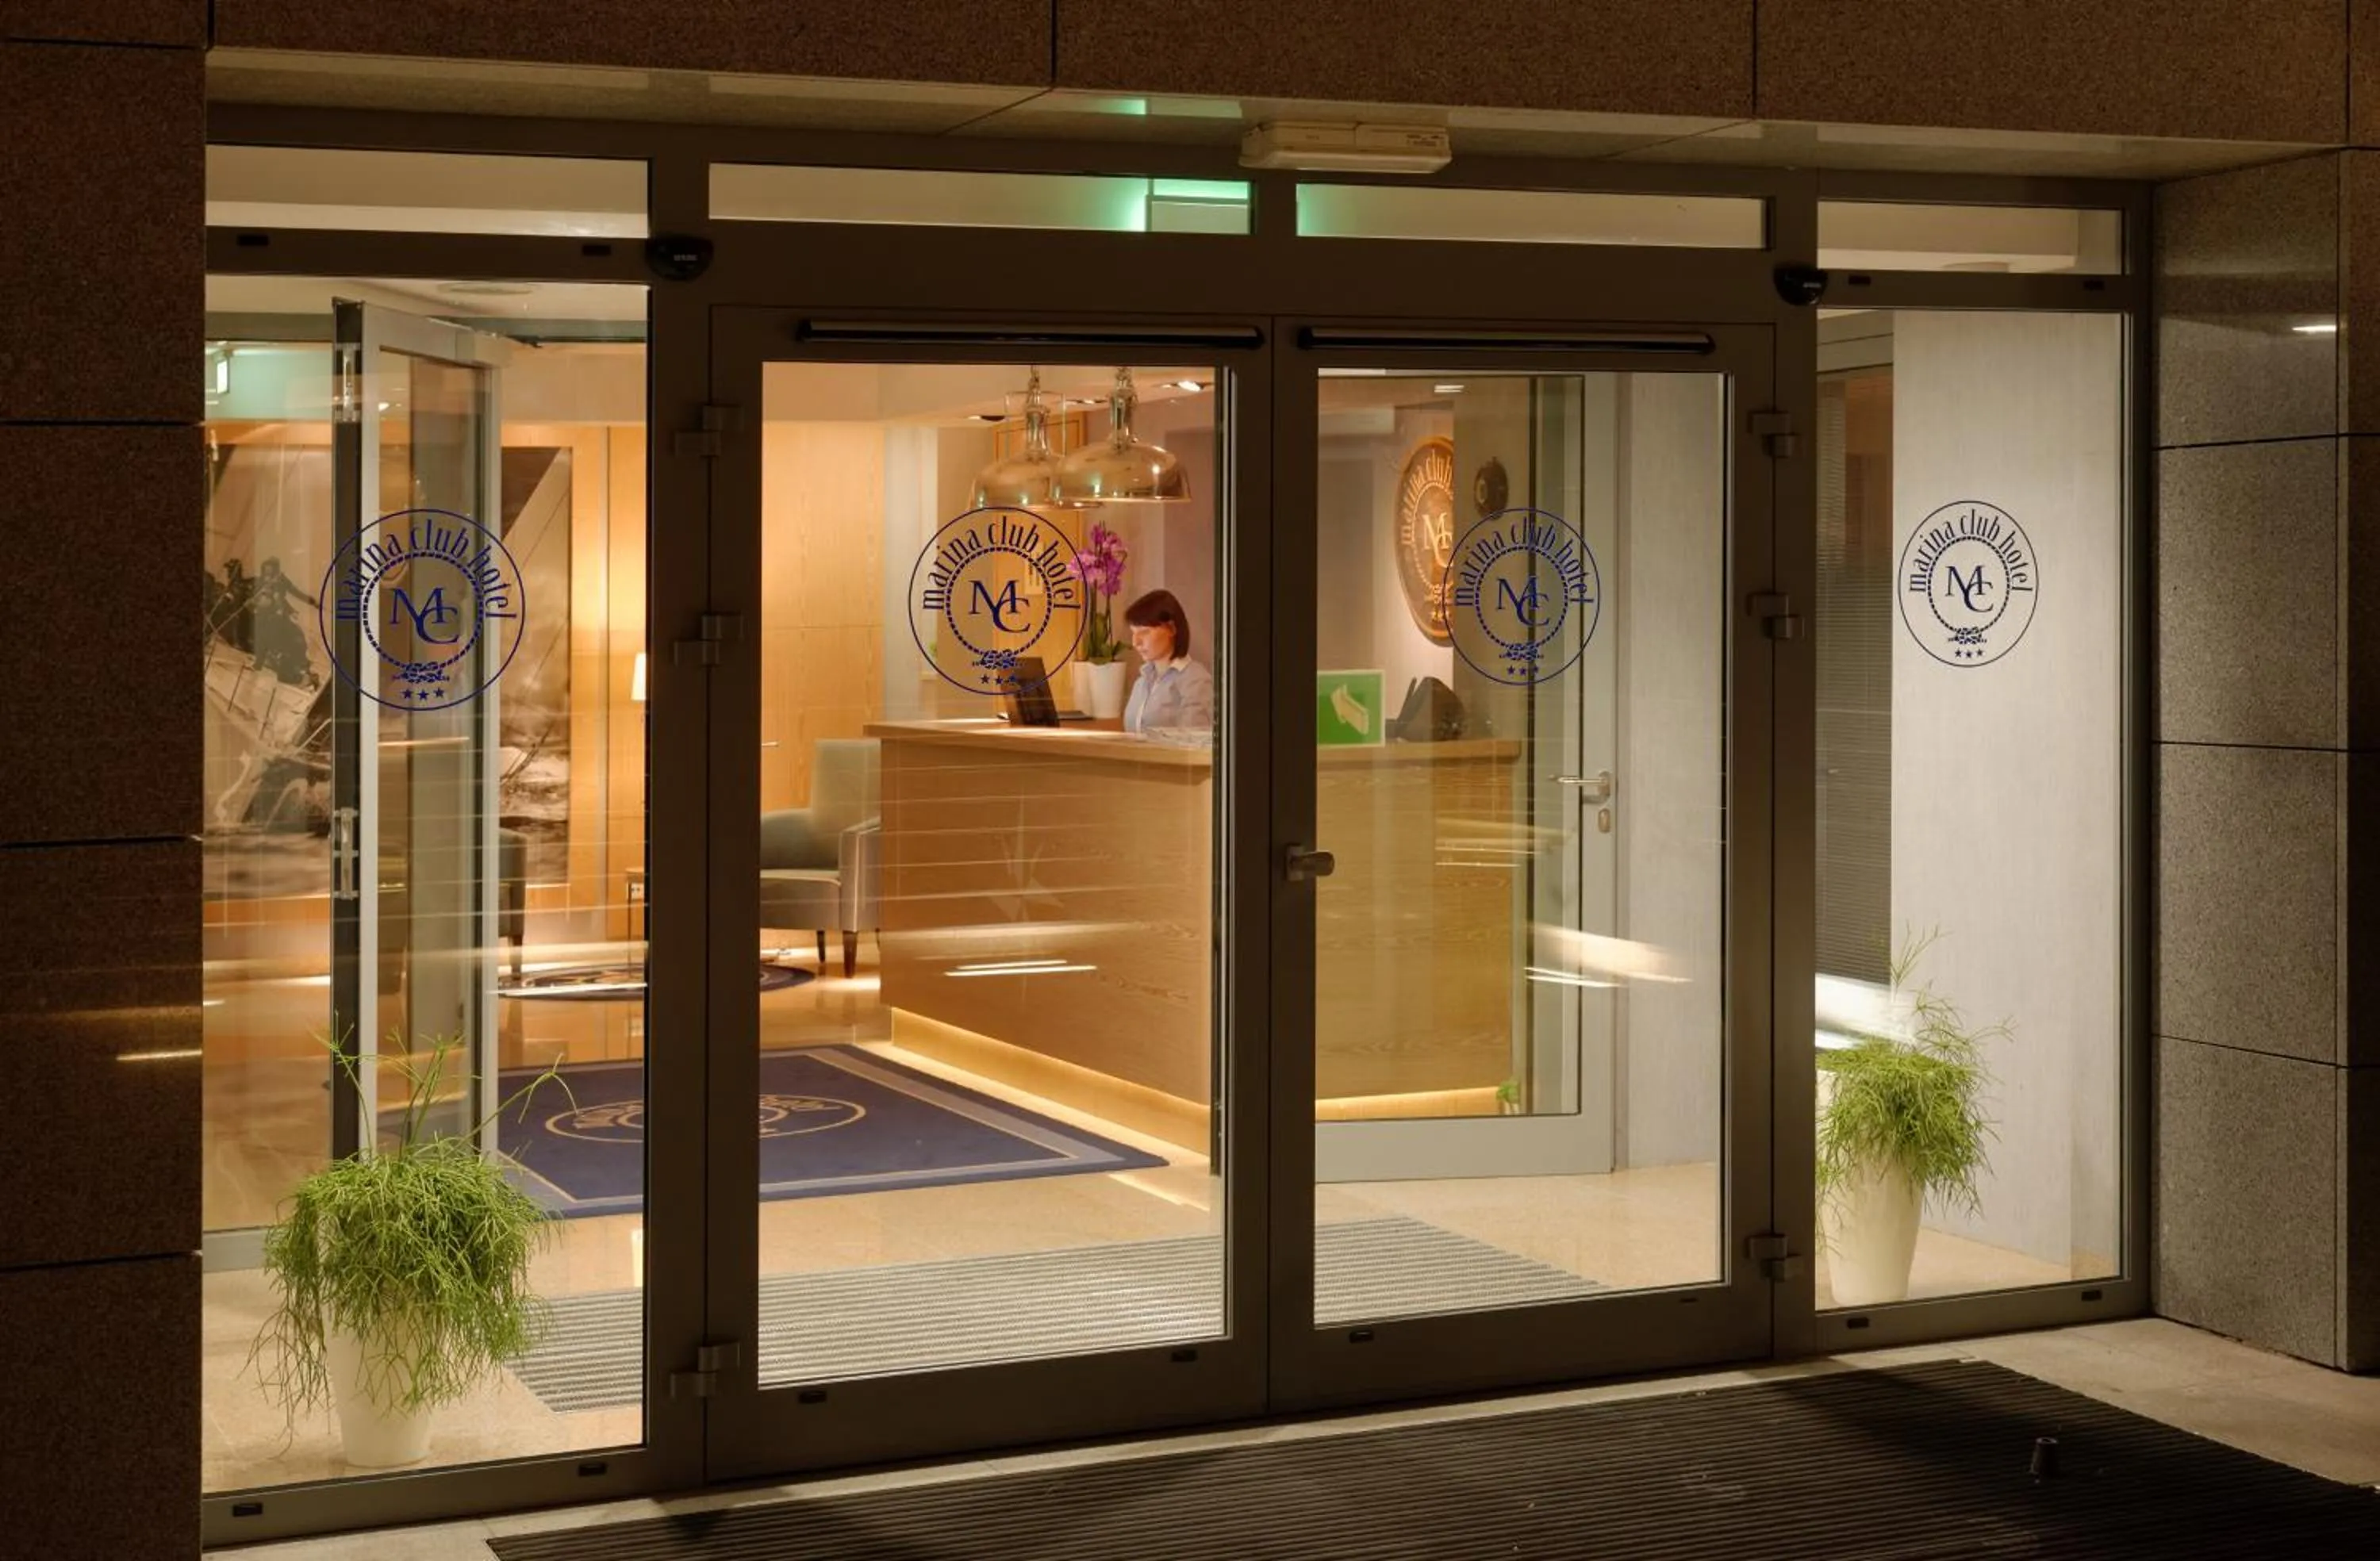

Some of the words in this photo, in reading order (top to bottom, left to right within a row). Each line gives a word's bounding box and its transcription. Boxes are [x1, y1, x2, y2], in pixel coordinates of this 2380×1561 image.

[336, 533, 402, 621] marina
[410, 519, 470, 559] club
[467, 544, 517, 619] hotel
[923, 529, 983, 610] marina
[988, 516, 1040, 553] club
[1037, 539, 1081, 610] hotel
[1454, 531, 1507, 607] marina
[1511, 516, 1556, 549] club
[1555, 539, 1595, 604] hotel
[1909, 520, 1956, 593] marina
[1960, 508, 2001, 543] club
[1998, 531, 2033, 592] hotel
[389, 587, 459, 645] MC
[969, 580, 1031, 633] MC
[1496, 577, 1550, 627] MC
[1944, 565, 1994, 613] MC
